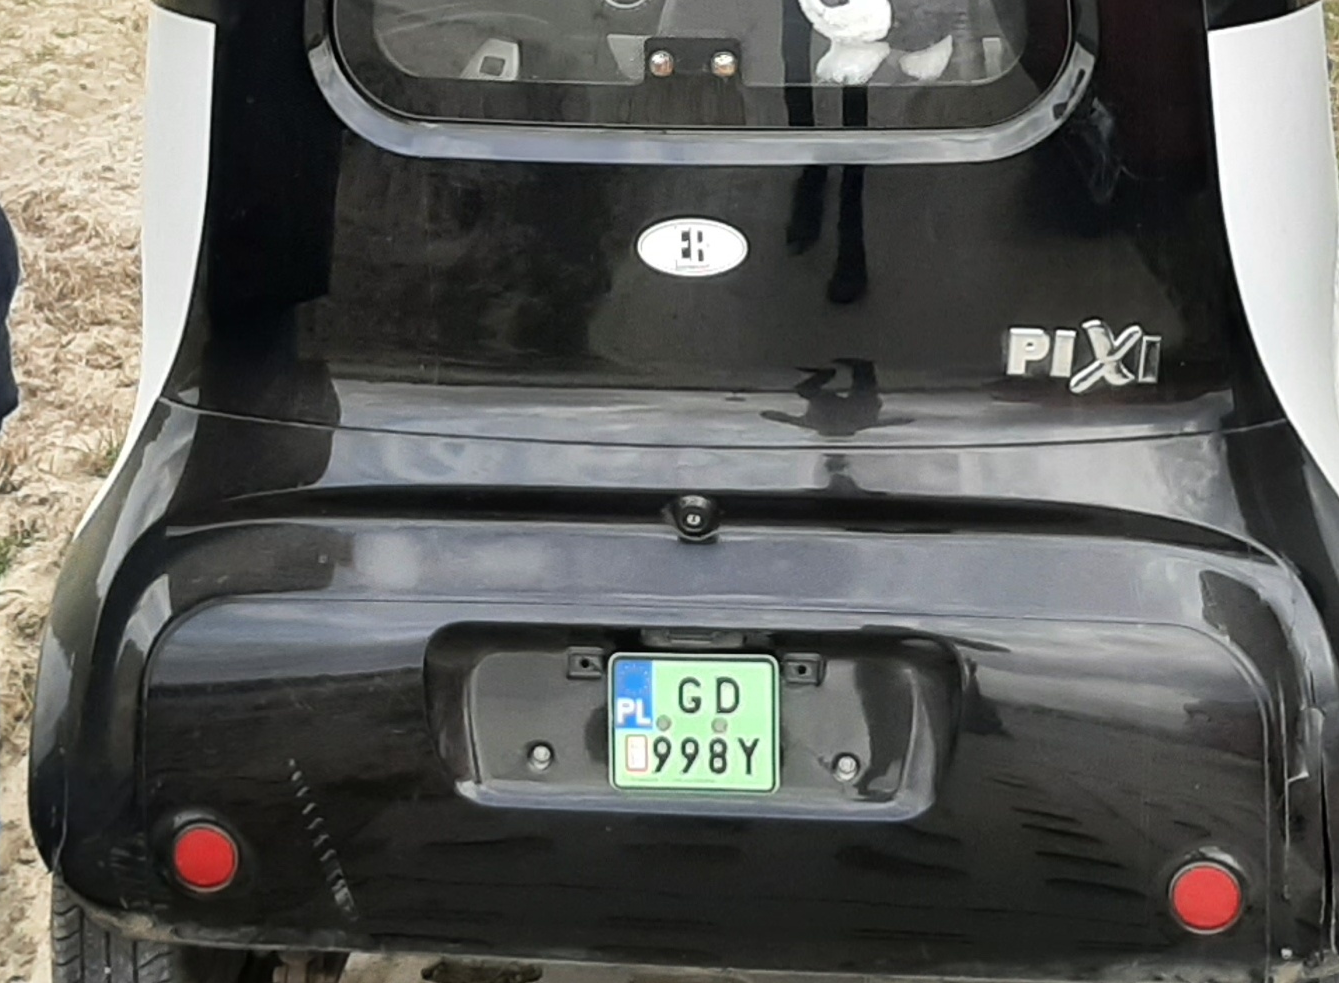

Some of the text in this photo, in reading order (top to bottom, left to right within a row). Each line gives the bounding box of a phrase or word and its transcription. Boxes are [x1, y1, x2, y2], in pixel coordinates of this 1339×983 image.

[1006, 319, 1161, 393] PIXI
[616, 696, 652, 726] PL
[678, 676, 740, 715] GD
[652, 735, 760, 776] 998Y
